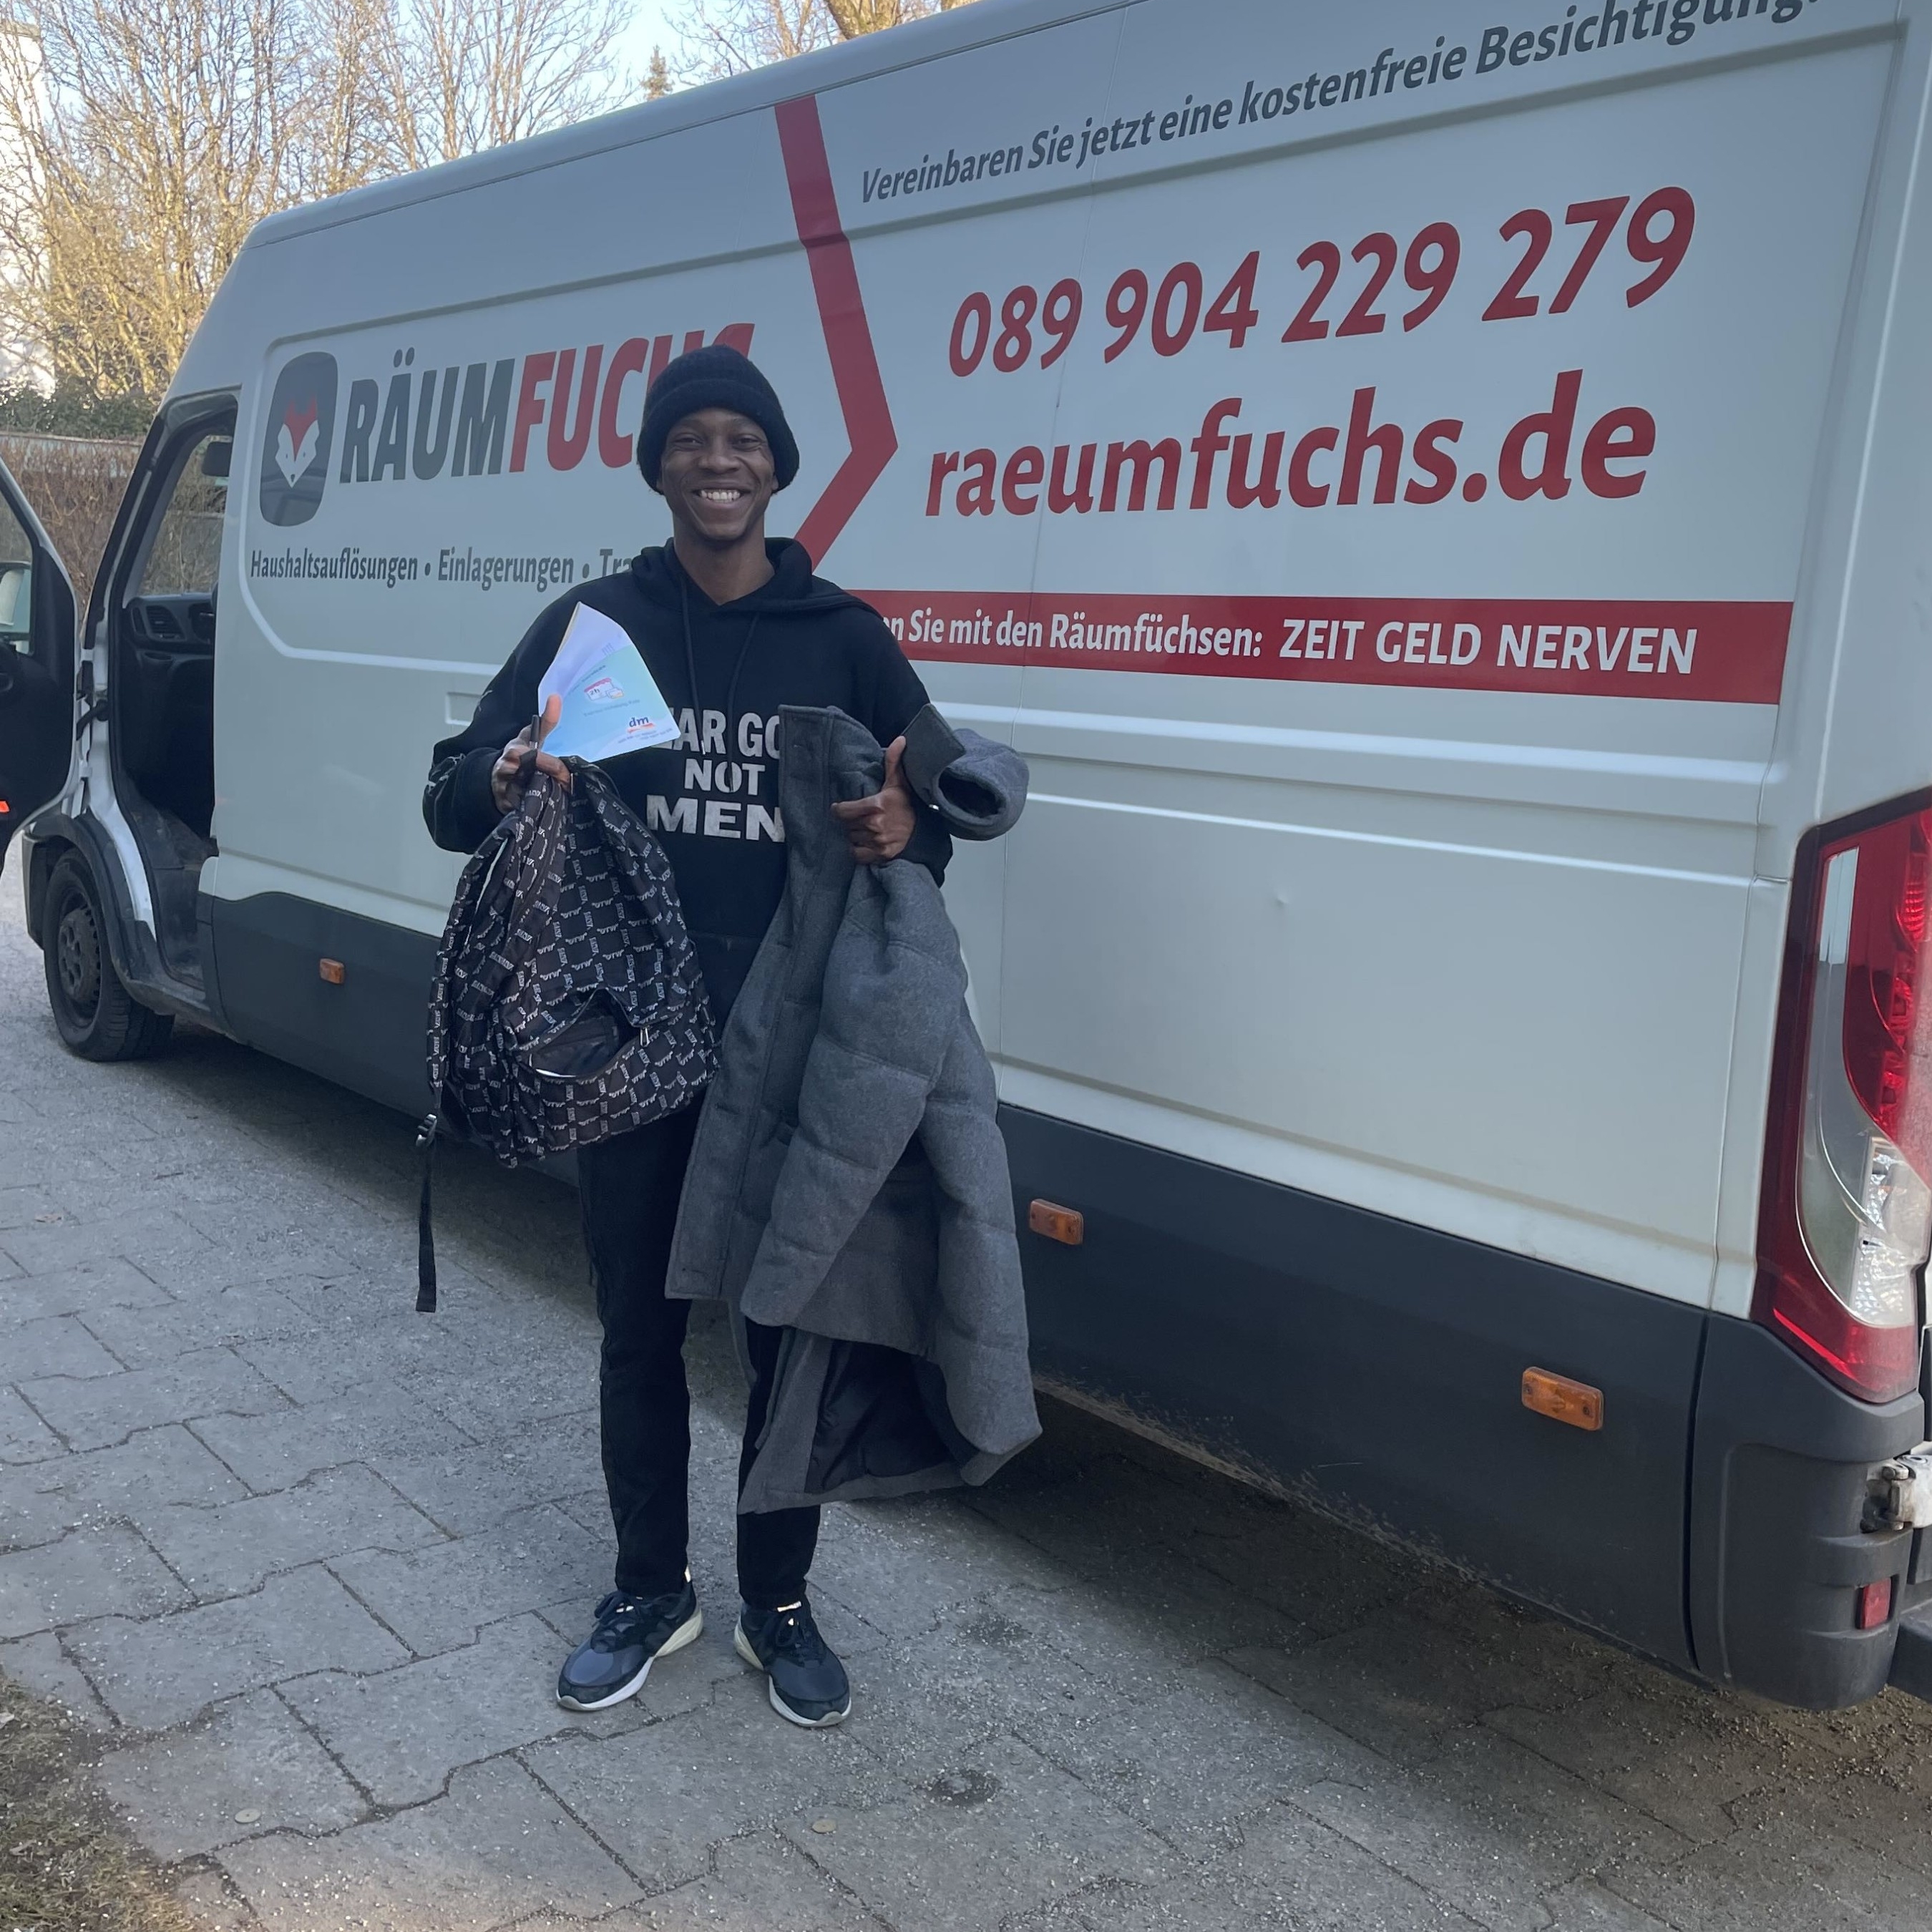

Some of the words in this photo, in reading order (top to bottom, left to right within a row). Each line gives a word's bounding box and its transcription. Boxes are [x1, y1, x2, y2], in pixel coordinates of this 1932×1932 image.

[862, 145, 1023, 203] Vereinbaren
[1027, 125, 1074, 169] Sie
[1075, 110, 1156, 170] jetzt
[1159, 94, 1233, 142] eine
[1238, 35, 1467, 125] kostenfreie
[950, 279, 1082, 376] 089
[1104, 251, 1259, 362] 904
[1282, 222, 1460, 343] 229
[1482, 187, 1695, 321] 279
[339, 322, 756, 484] RÄUMFUC
[925, 370, 1656, 517] raeumfuchs.de
[250, 547, 418, 589] Haushaltsauflösungen
[438, 547, 574, 592] Einlagerungen
[908, 607, 945, 643] Sie
[949, 608, 993, 645] mit
[995, 610, 1043, 648] den
[1049, 611, 1262, 657] Räumfüchsen:
[1279, 619, 1365, 660] ZEIT
[1376, 621, 1481, 665] GELD
[1496, 624, 1697, 674] NERVEN
[629, 717, 649, 728] dm
[684, 758, 766, 796] NOT
[647, 795, 786, 843] MEN
